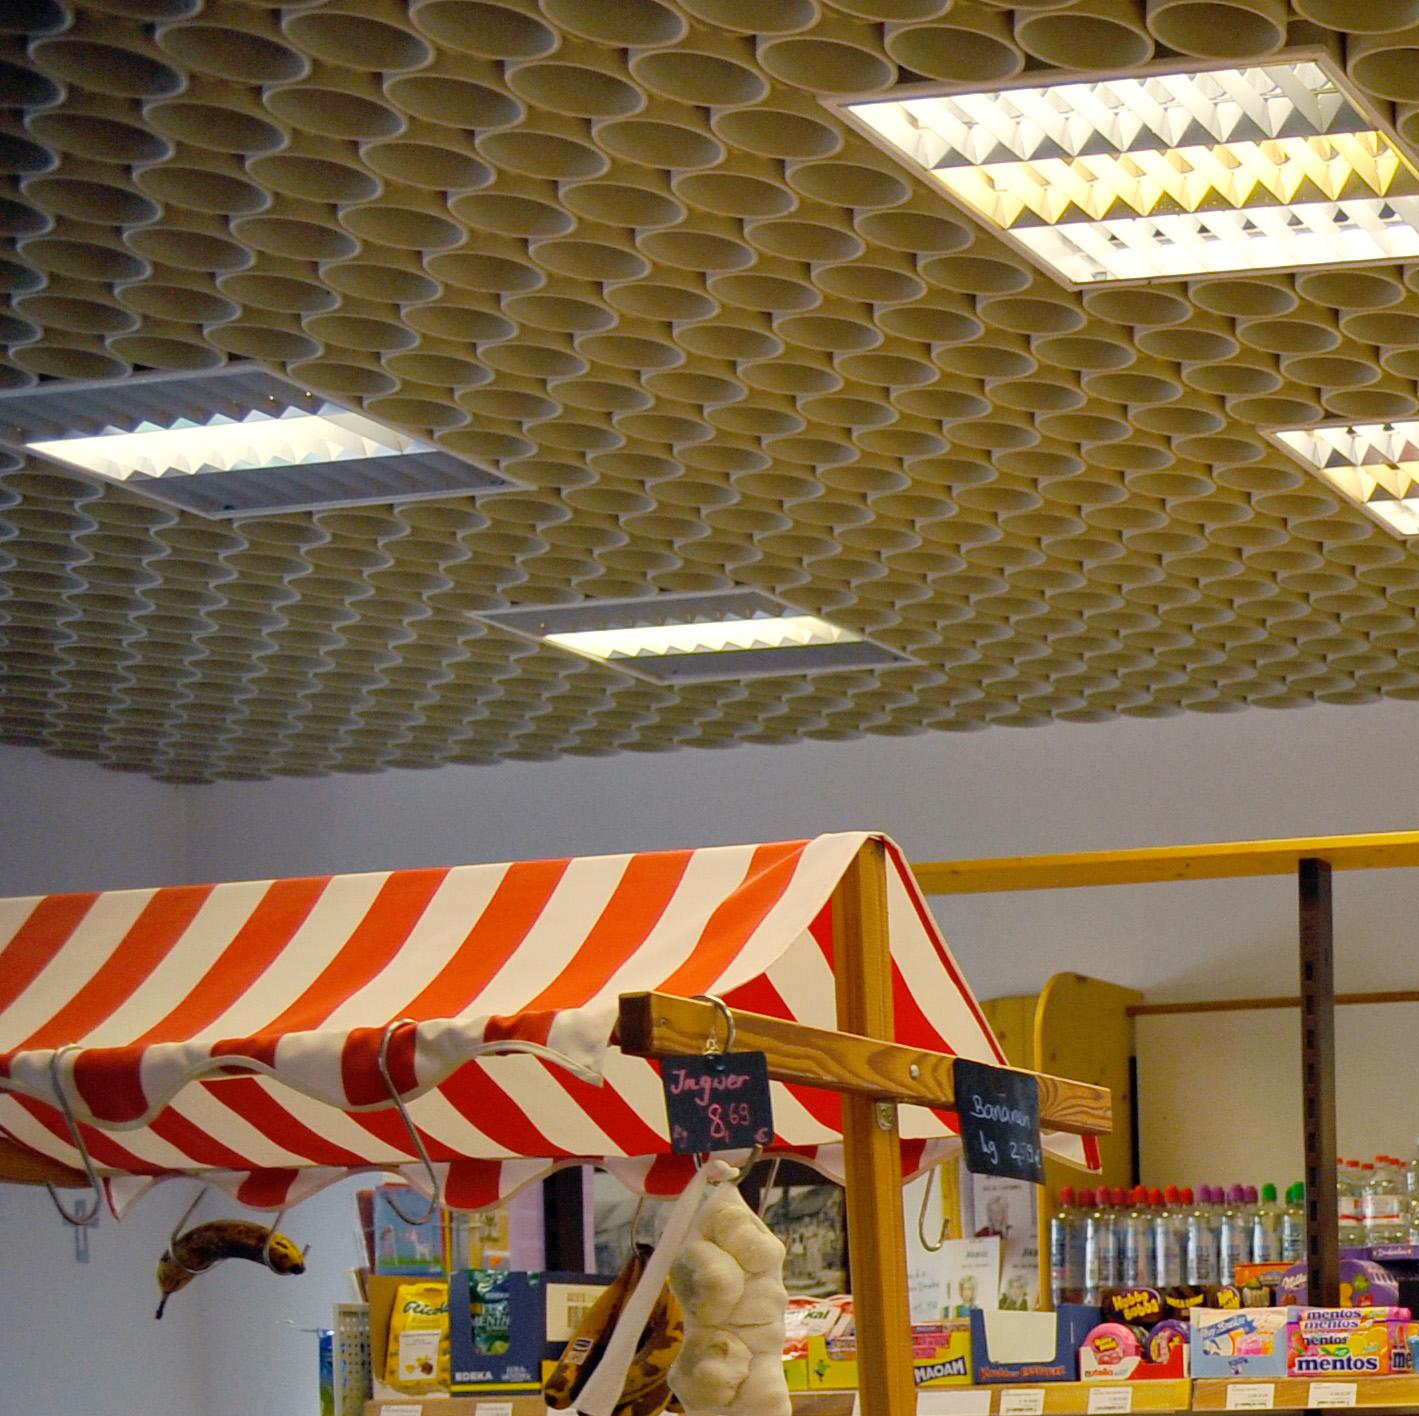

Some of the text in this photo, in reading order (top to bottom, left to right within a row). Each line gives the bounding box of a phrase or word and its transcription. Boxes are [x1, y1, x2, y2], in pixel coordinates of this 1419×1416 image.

[670, 1069, 751, 1106] Ingwer
[969, 1095, 1031, 1129] Bananen
[1306, 1310, 1361, 1320] mentos
[915, 1358, 965, 1385] MAOAM
[1296, 1355, 1379, 1373] mentos
[454, 1371, 493, 1381] EDEKA
